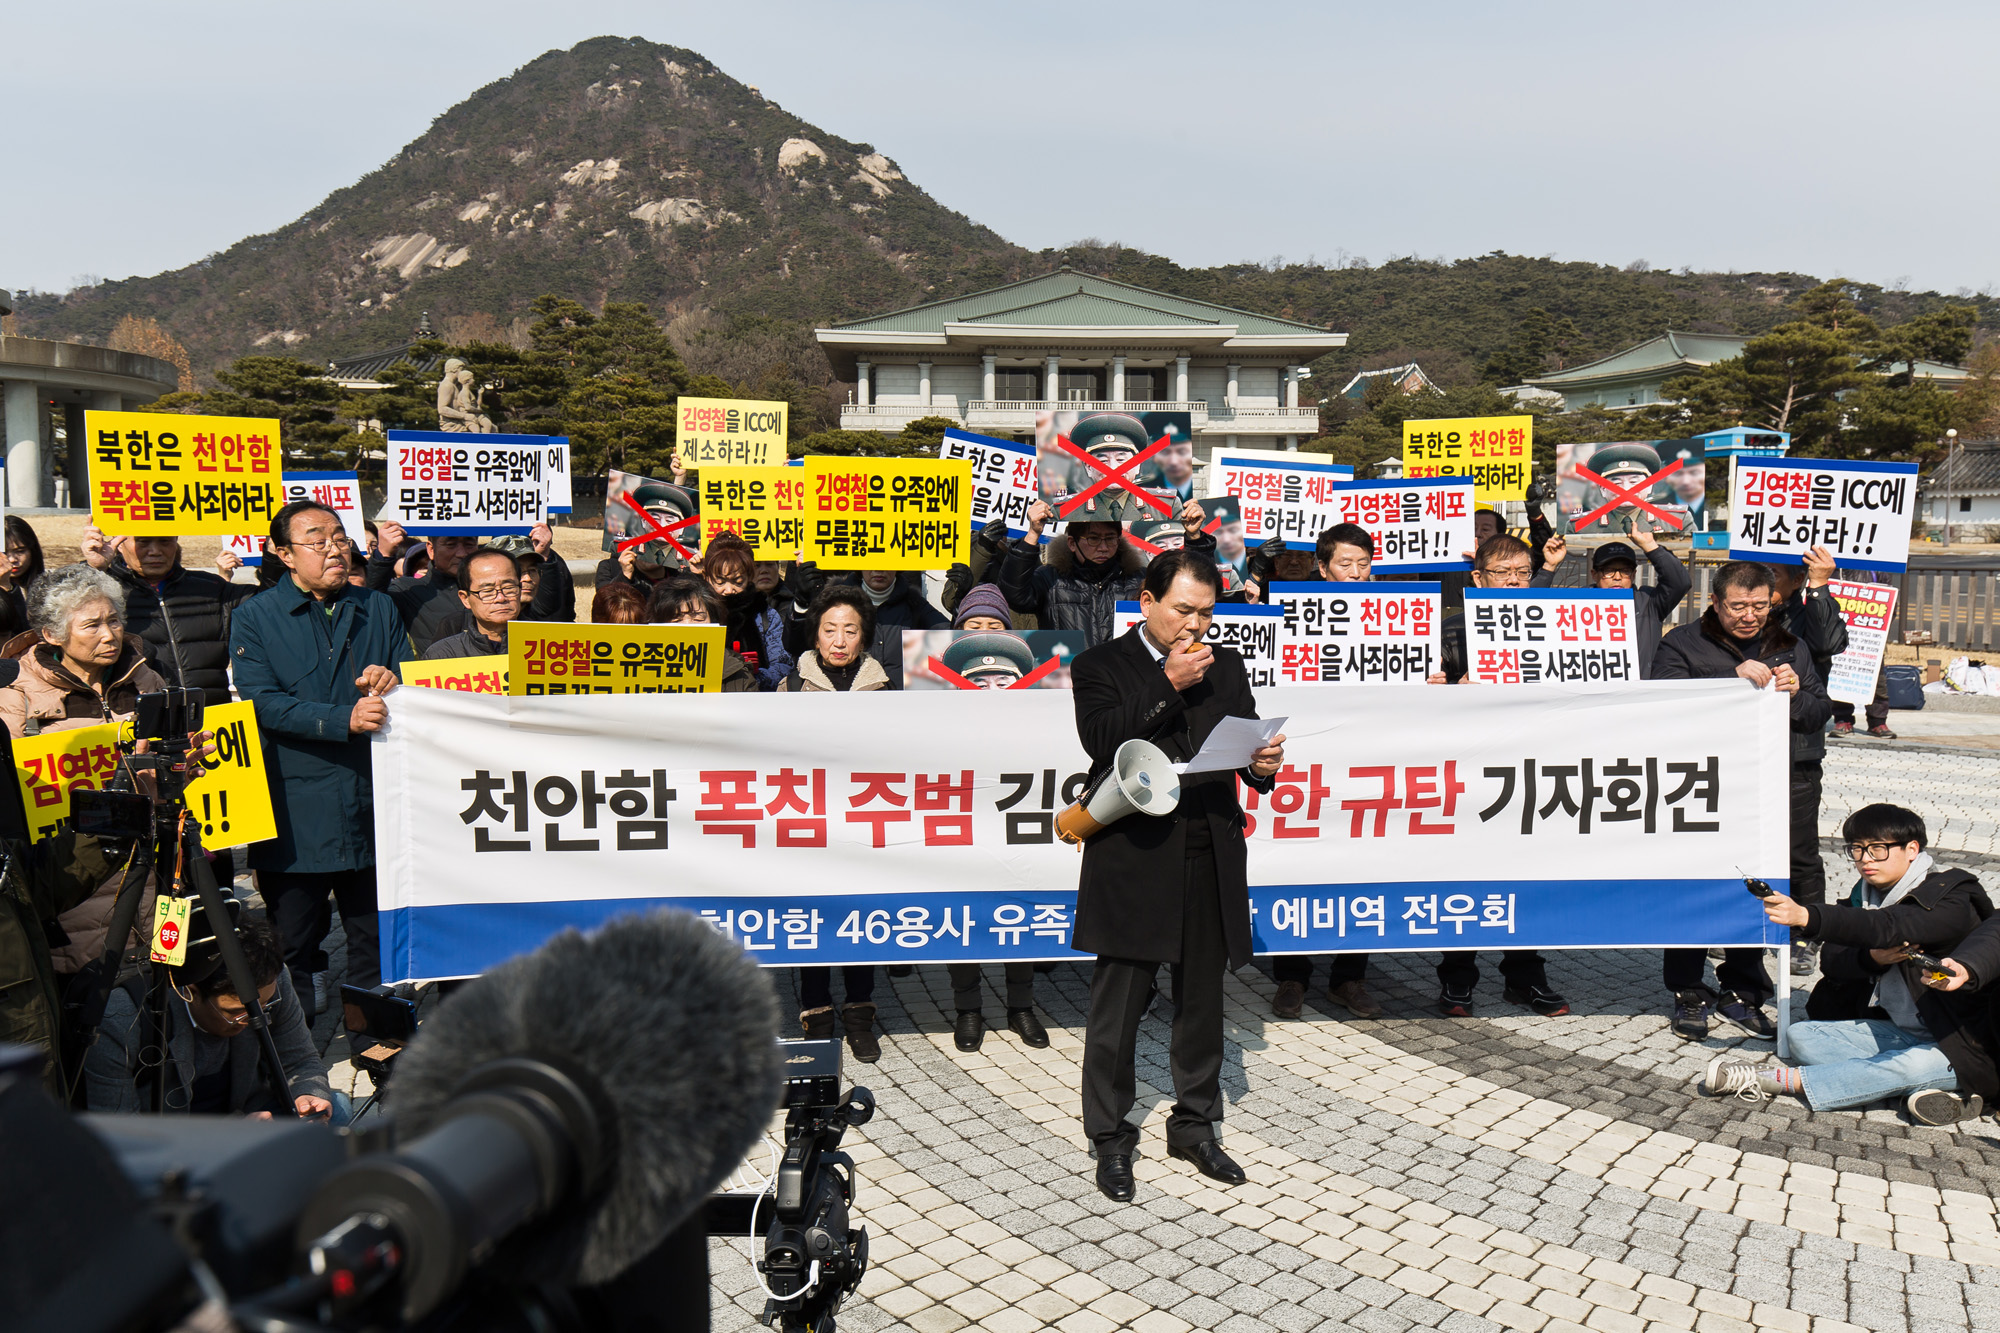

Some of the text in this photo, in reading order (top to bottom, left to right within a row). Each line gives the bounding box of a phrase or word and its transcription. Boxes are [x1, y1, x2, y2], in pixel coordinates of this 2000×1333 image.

[682, 407, 781, 435] 김영철을 ICC에
[96, 429, 272, 473] 북한은 천안함
[1408, 428, 1525, 459] 북한은 천안함
[399, 447, 542, 483] 김영철은 유족앞에
[1012, 457, 1038, 492] 천
[99, 480, 176, 521] 폭침을
[179, 481, 274, 521] 사죄하라
[399, 487, 471, 521] 무릎꿇고
[474, 488, 542, 521] 사죄하라
[705, 480, 766, 511] 북한은
[815, 472, 959, 513] 김영철은 유족앞에
[1225, 471, 1303, 503] 김영철을
[1743, 471, 1906, 515] 김영철을 ICC에
[1340, 490, 1467, 525] 김영철을 체포
[814, 519, 959, 558] 무릎꿇고 사죄하라
[1280, 598, 1434, 636] 북한은 천안함
[1474, 604, 1628, 642] 북한은 천안함
[523, 639, 708, 678] 김영철은 유족앞에
[1281, 644, 1342, 682] 폭침을
[1345, 643, 1433, 682] 사죄하라
[1476, 648, 1631, 684] 폭침을 사죄하라
[459, 769, 677, 852] 천안함
[695, 768, 827, 848] 폭침
[845, 769, 974, 848] 주범
[1341, 760, 1465, 838] 규탄
[1478, 756, 1720, 835] 기자회견
[161, 929, 178, 943] 영우
[836, 905, 976, 948] 46용사
[989, 904, 1077, 946] 유족
[1271, 895, 1385, 938] 예비역
[1401, 893, 1516, 935] 전우회
